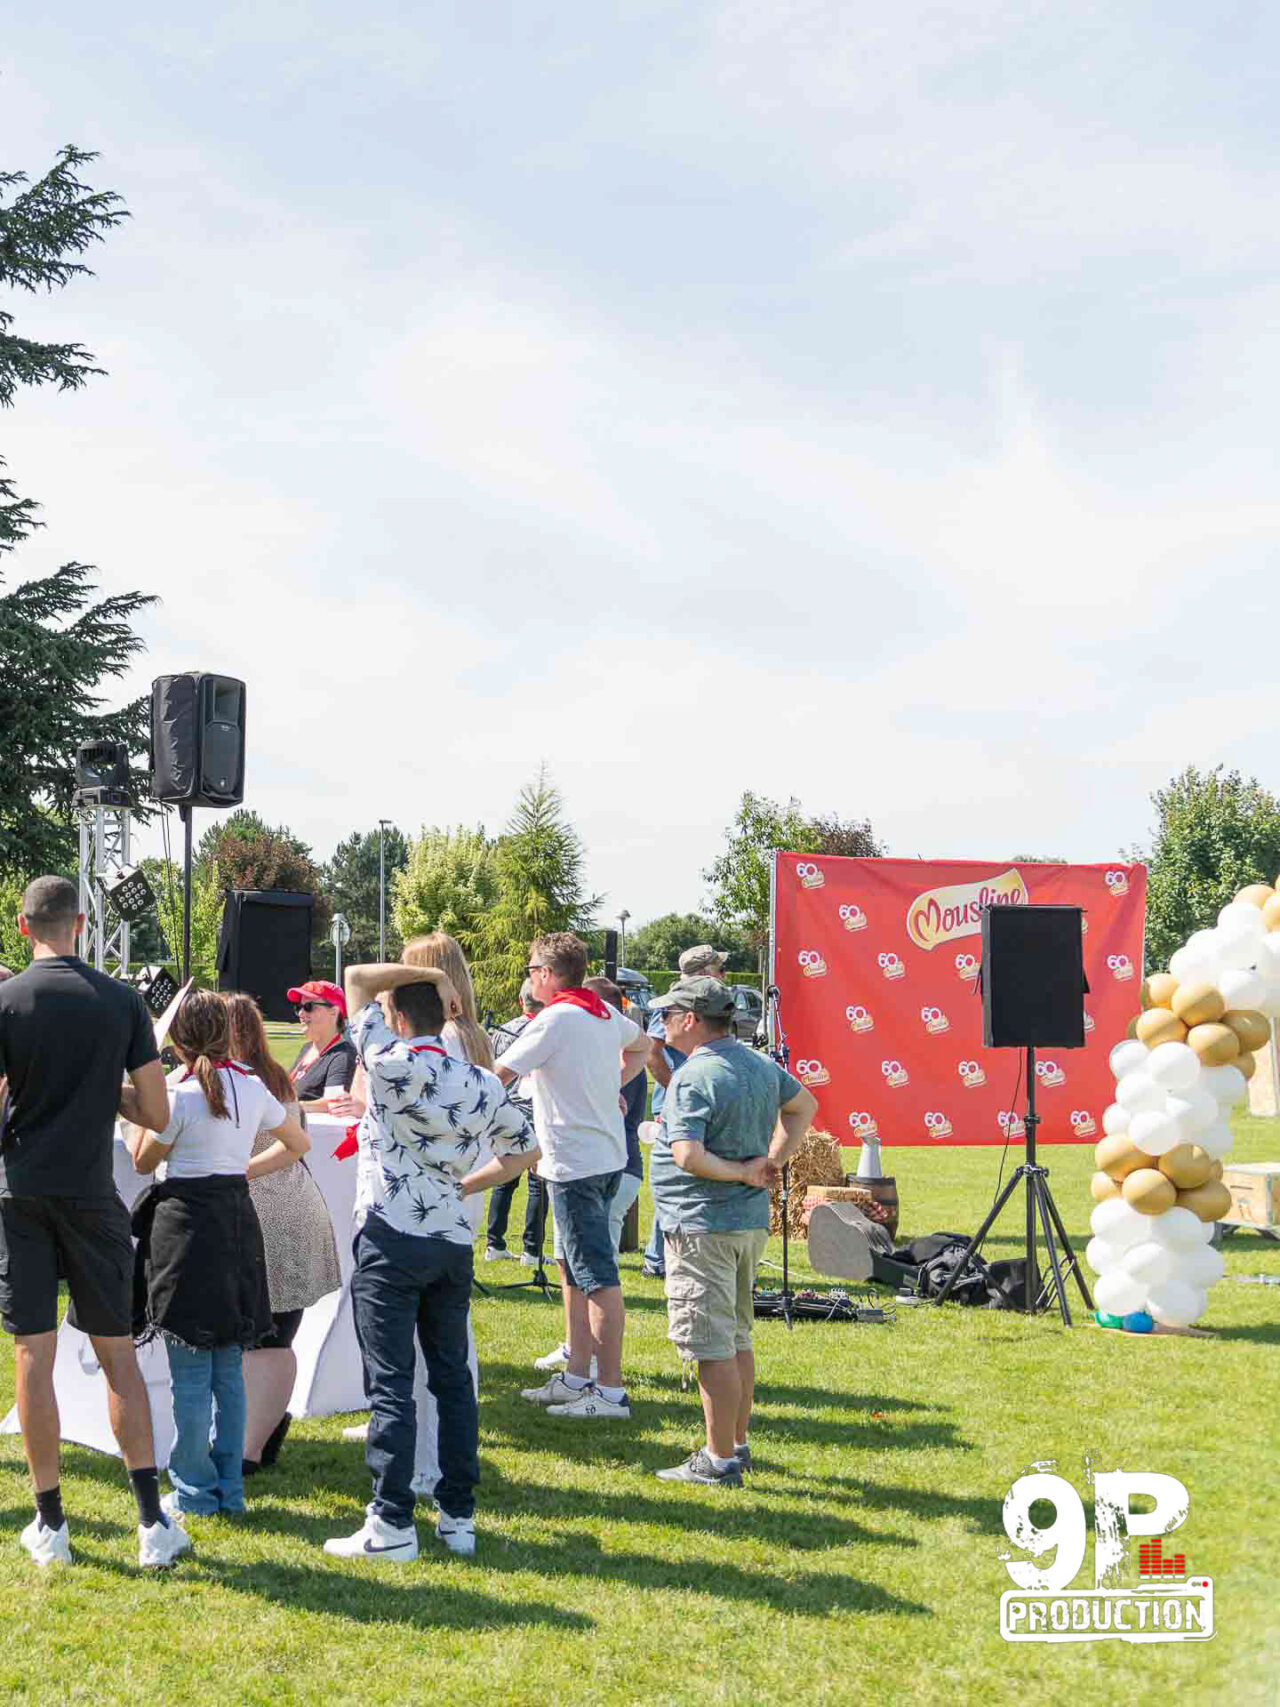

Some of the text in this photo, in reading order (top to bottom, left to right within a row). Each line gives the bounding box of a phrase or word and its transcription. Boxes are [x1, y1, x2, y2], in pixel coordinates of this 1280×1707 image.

[796, 863, 818, 877] 60
[1105, 871, 1126, 886] 60
[839, 905, 860, 920] 60
[914, 886, 1021, 942] Mousline
[798, 950, 820, 966] 60
[878, 952, 898, 968] 60
[955, 954, 975, 969] 60
[1107, 955, 1128, 970] 60
[846, 1006, 867, 1021] 60
[921, 1007, 941, 1022] 60
[796, 1059, 821, 1075] 60
[882, 1060, 901, 1076] 60
[958, 1061, 979, 1076] 60
[1035, 1061, 1057, 1076] 60
[849, 1112, 871, 1127] 60
[924, 1112, 945, 1127] 60
[997, 1111, 1018, 1127] 60
[1070, 1110, 1090, 1126] 60
